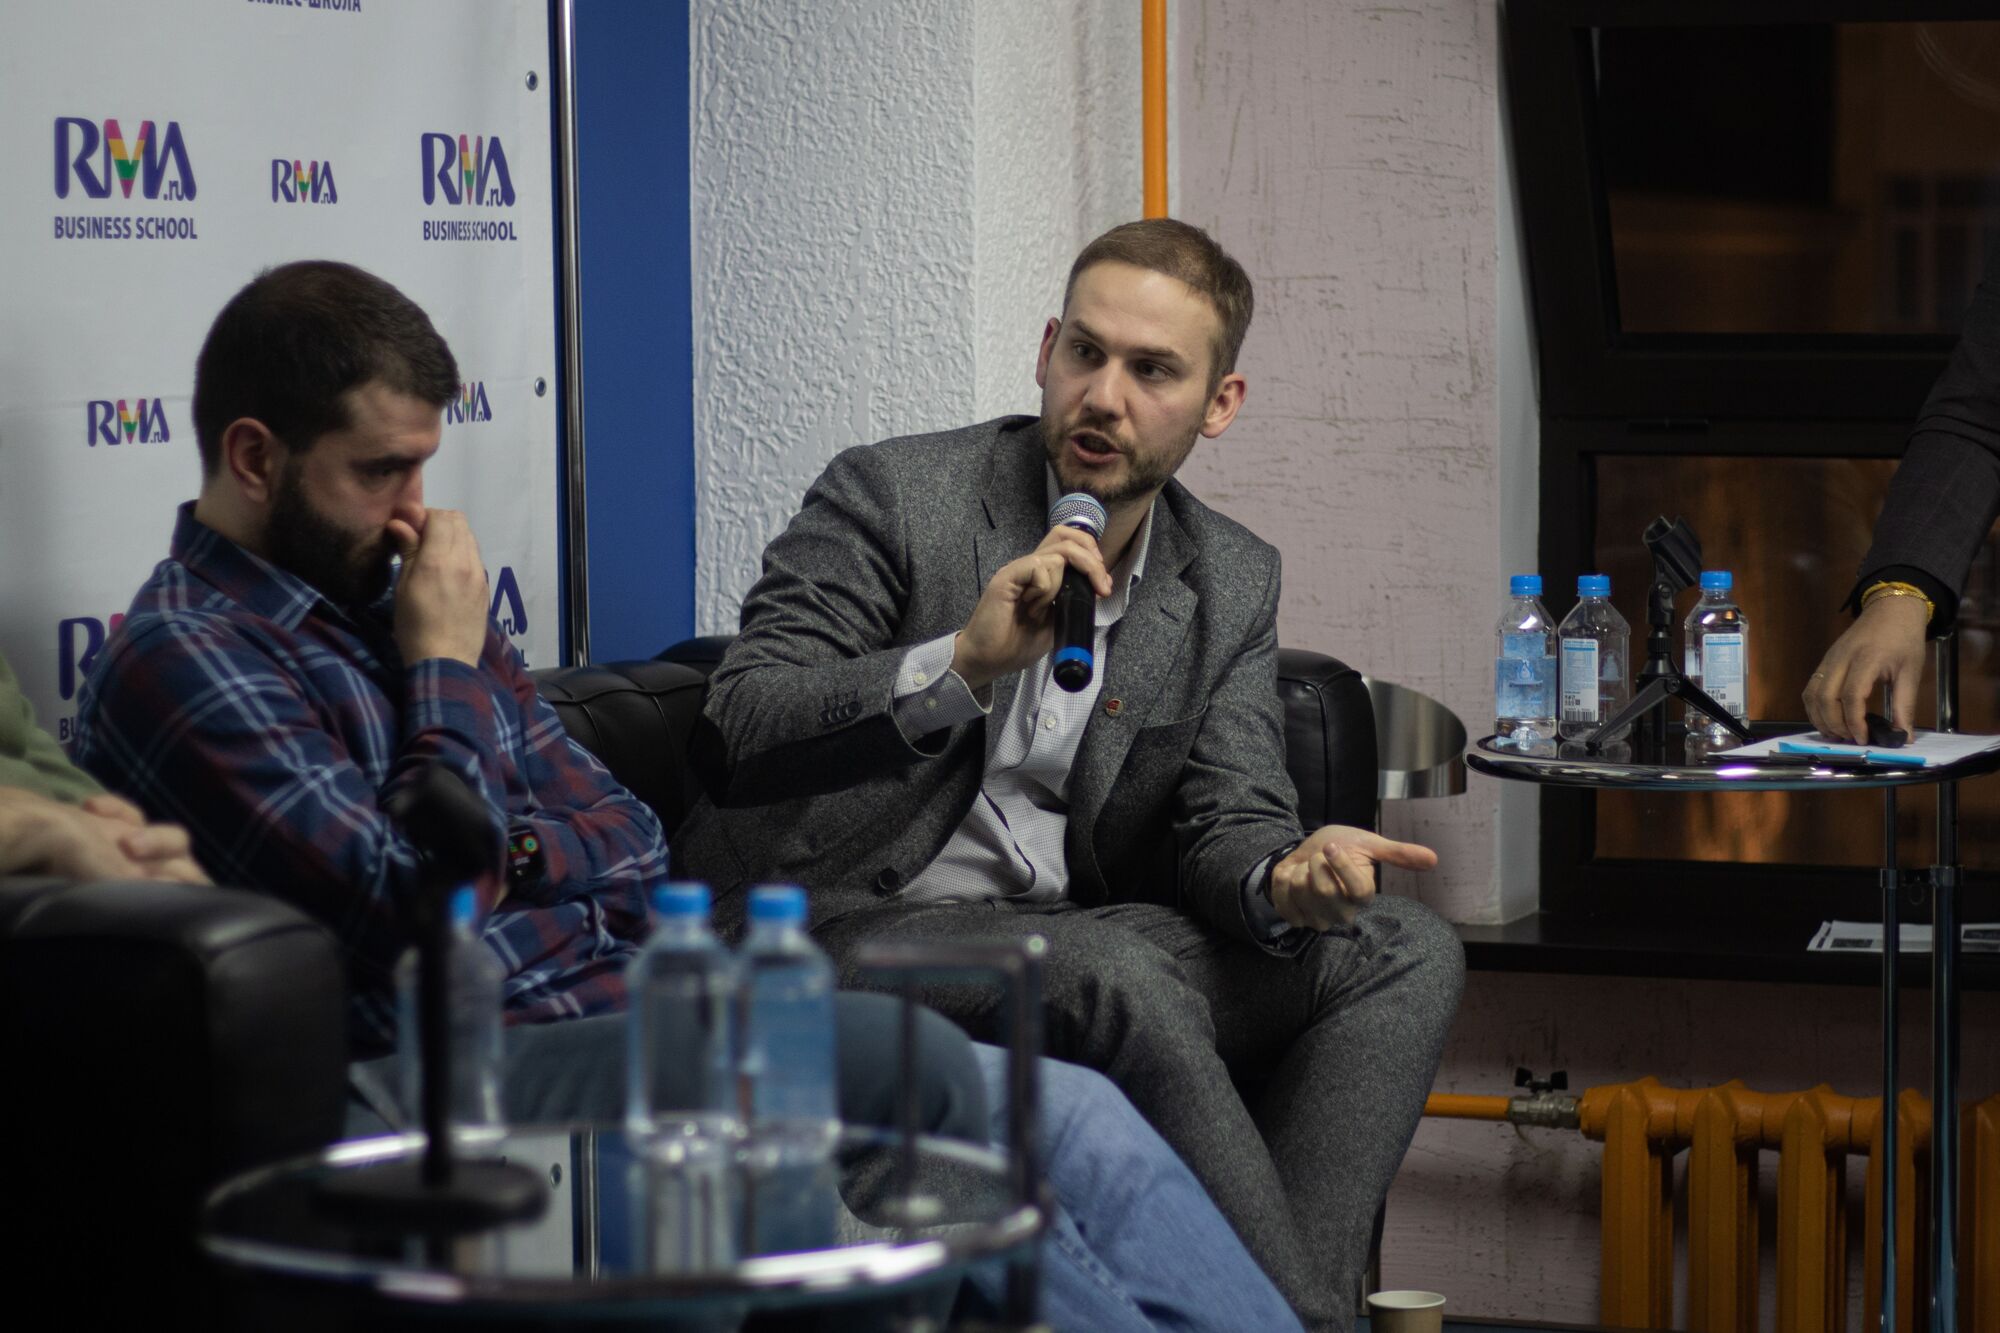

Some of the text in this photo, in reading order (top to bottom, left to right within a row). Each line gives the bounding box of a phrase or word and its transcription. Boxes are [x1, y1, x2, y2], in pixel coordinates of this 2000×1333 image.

[54, 216, 198, 240] BUSINESS SCHOOL
[423, 220, 518, 241] BUSINESS SCHOOL
